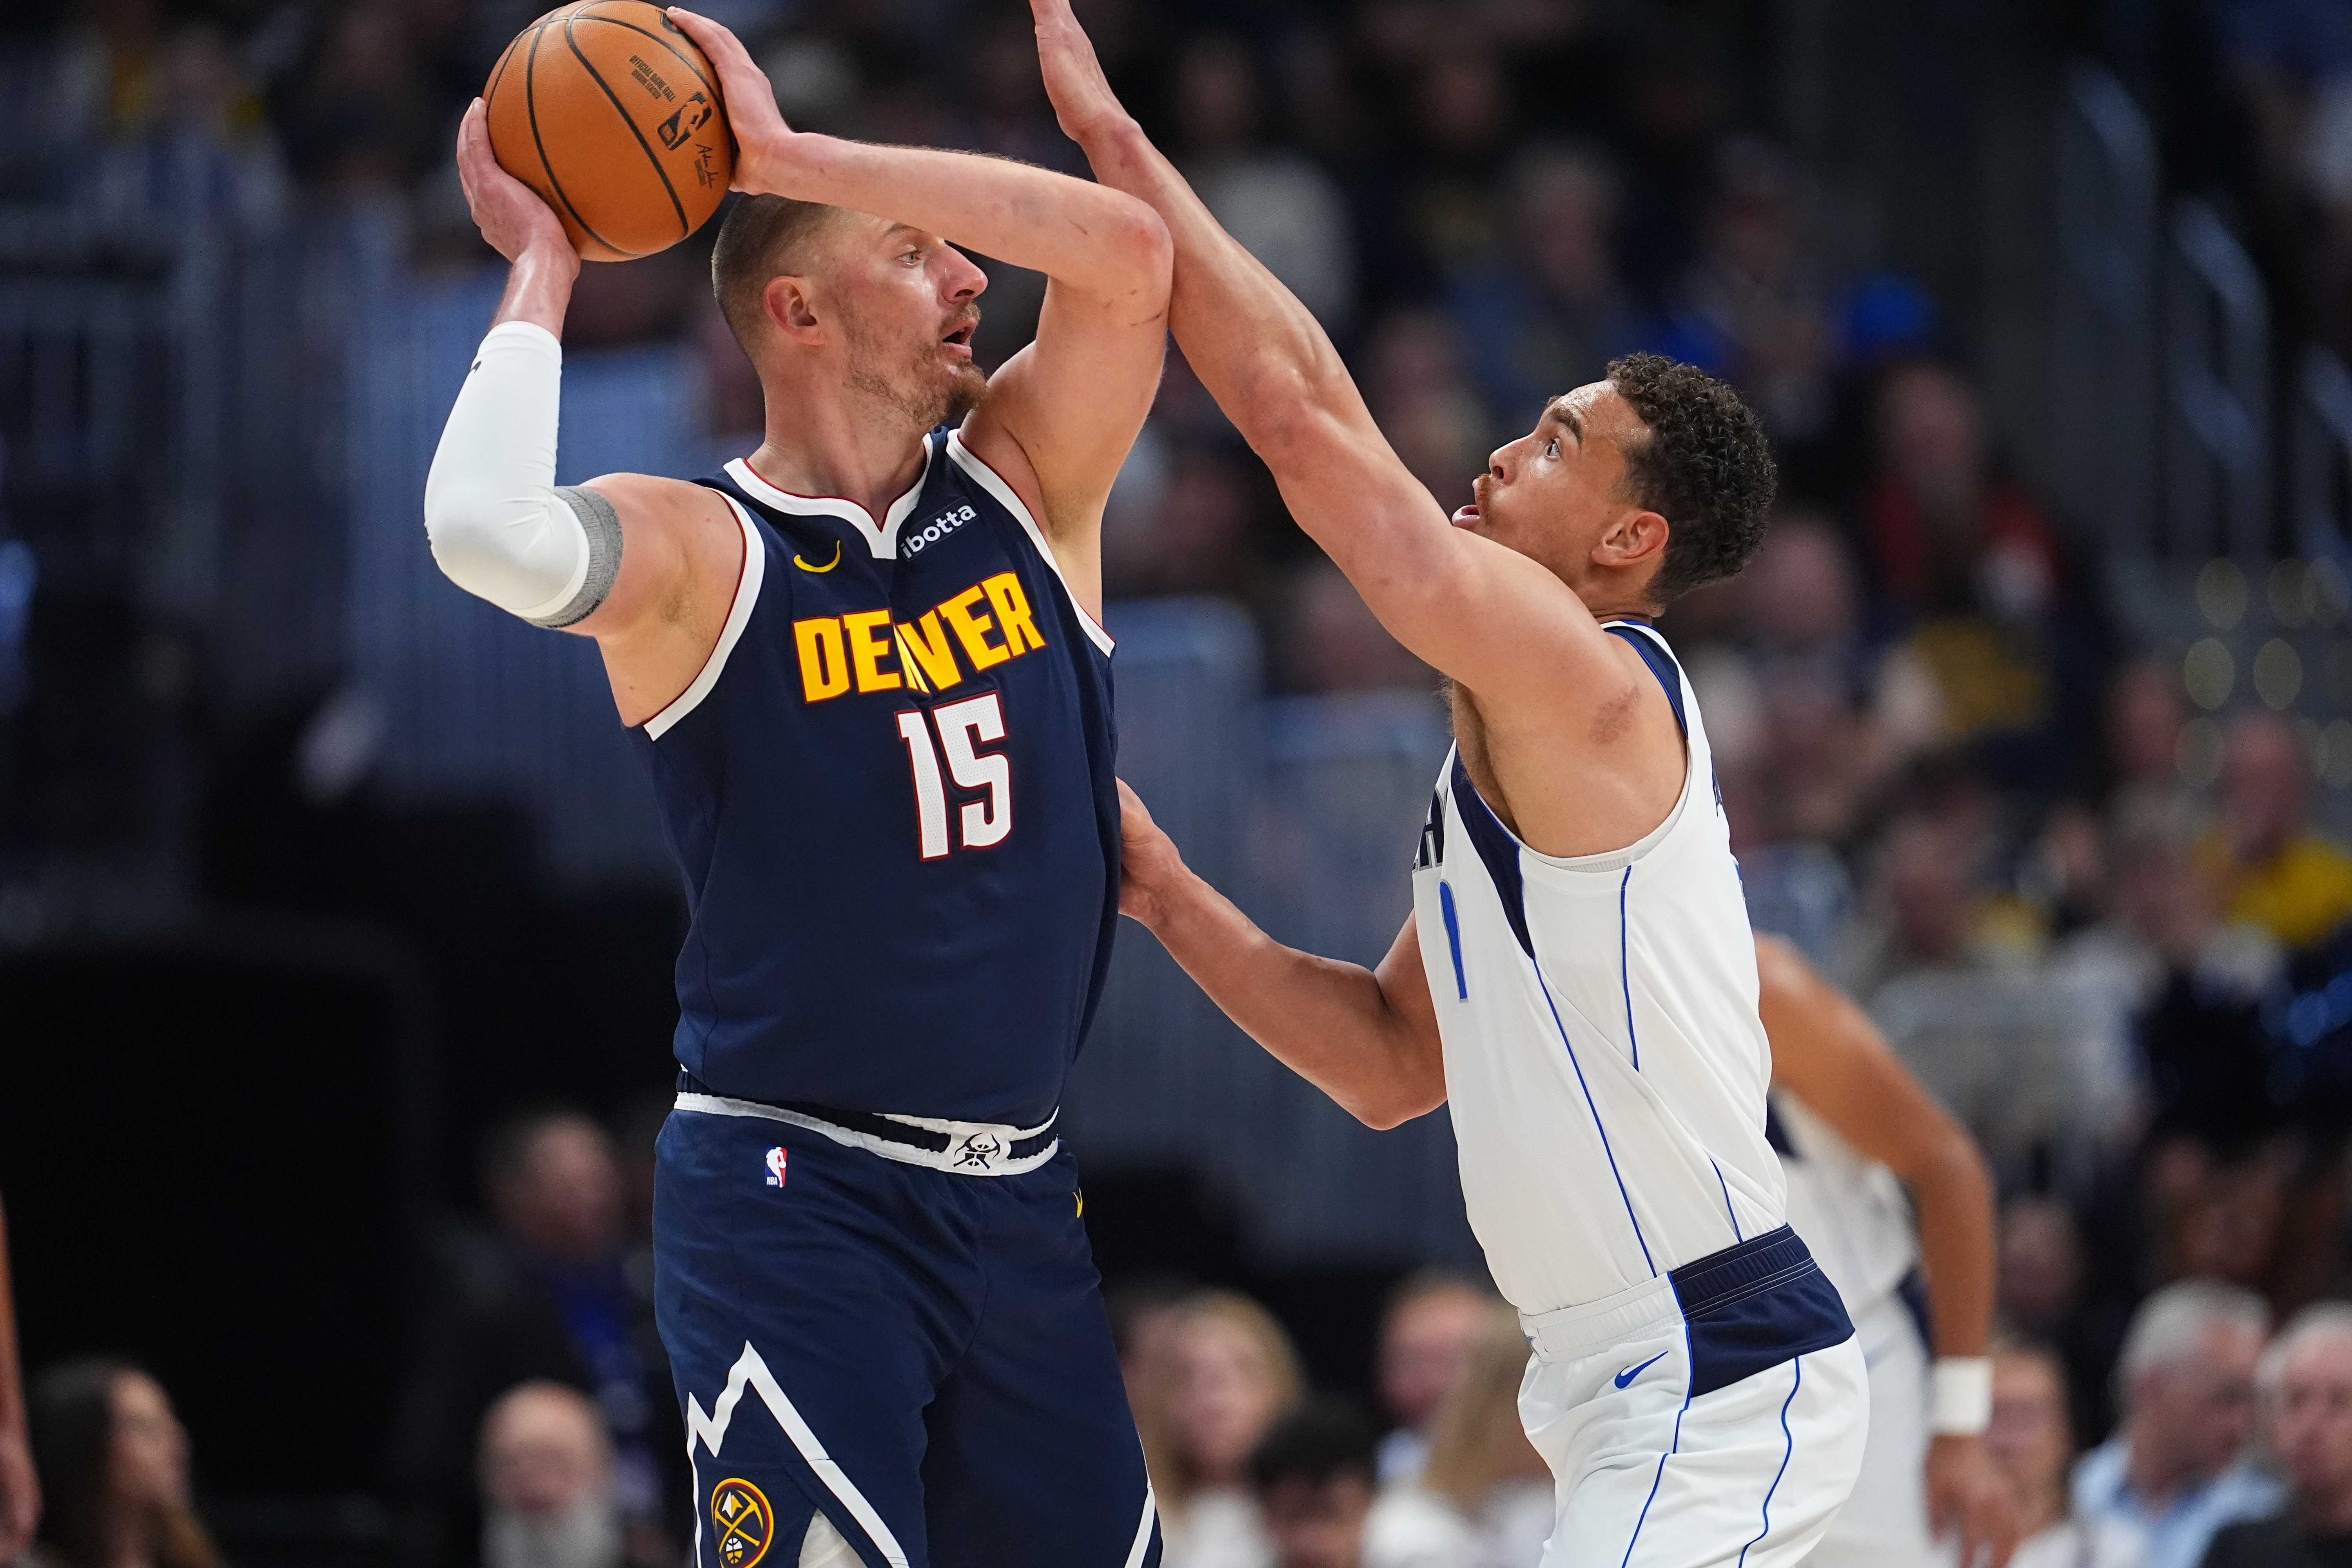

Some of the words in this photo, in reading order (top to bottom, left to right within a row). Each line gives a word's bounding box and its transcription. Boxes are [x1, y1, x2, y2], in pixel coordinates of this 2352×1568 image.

[630, 54, 653, 77] OFFICIAL
[649, 73, 666, 91] GAME
[662, 85, 676, 102] BALL
[901, 504, 977, 559] ibotta
[793, 570, 1047, 704] DENVER
[895, 690, 1013, 861] 15
